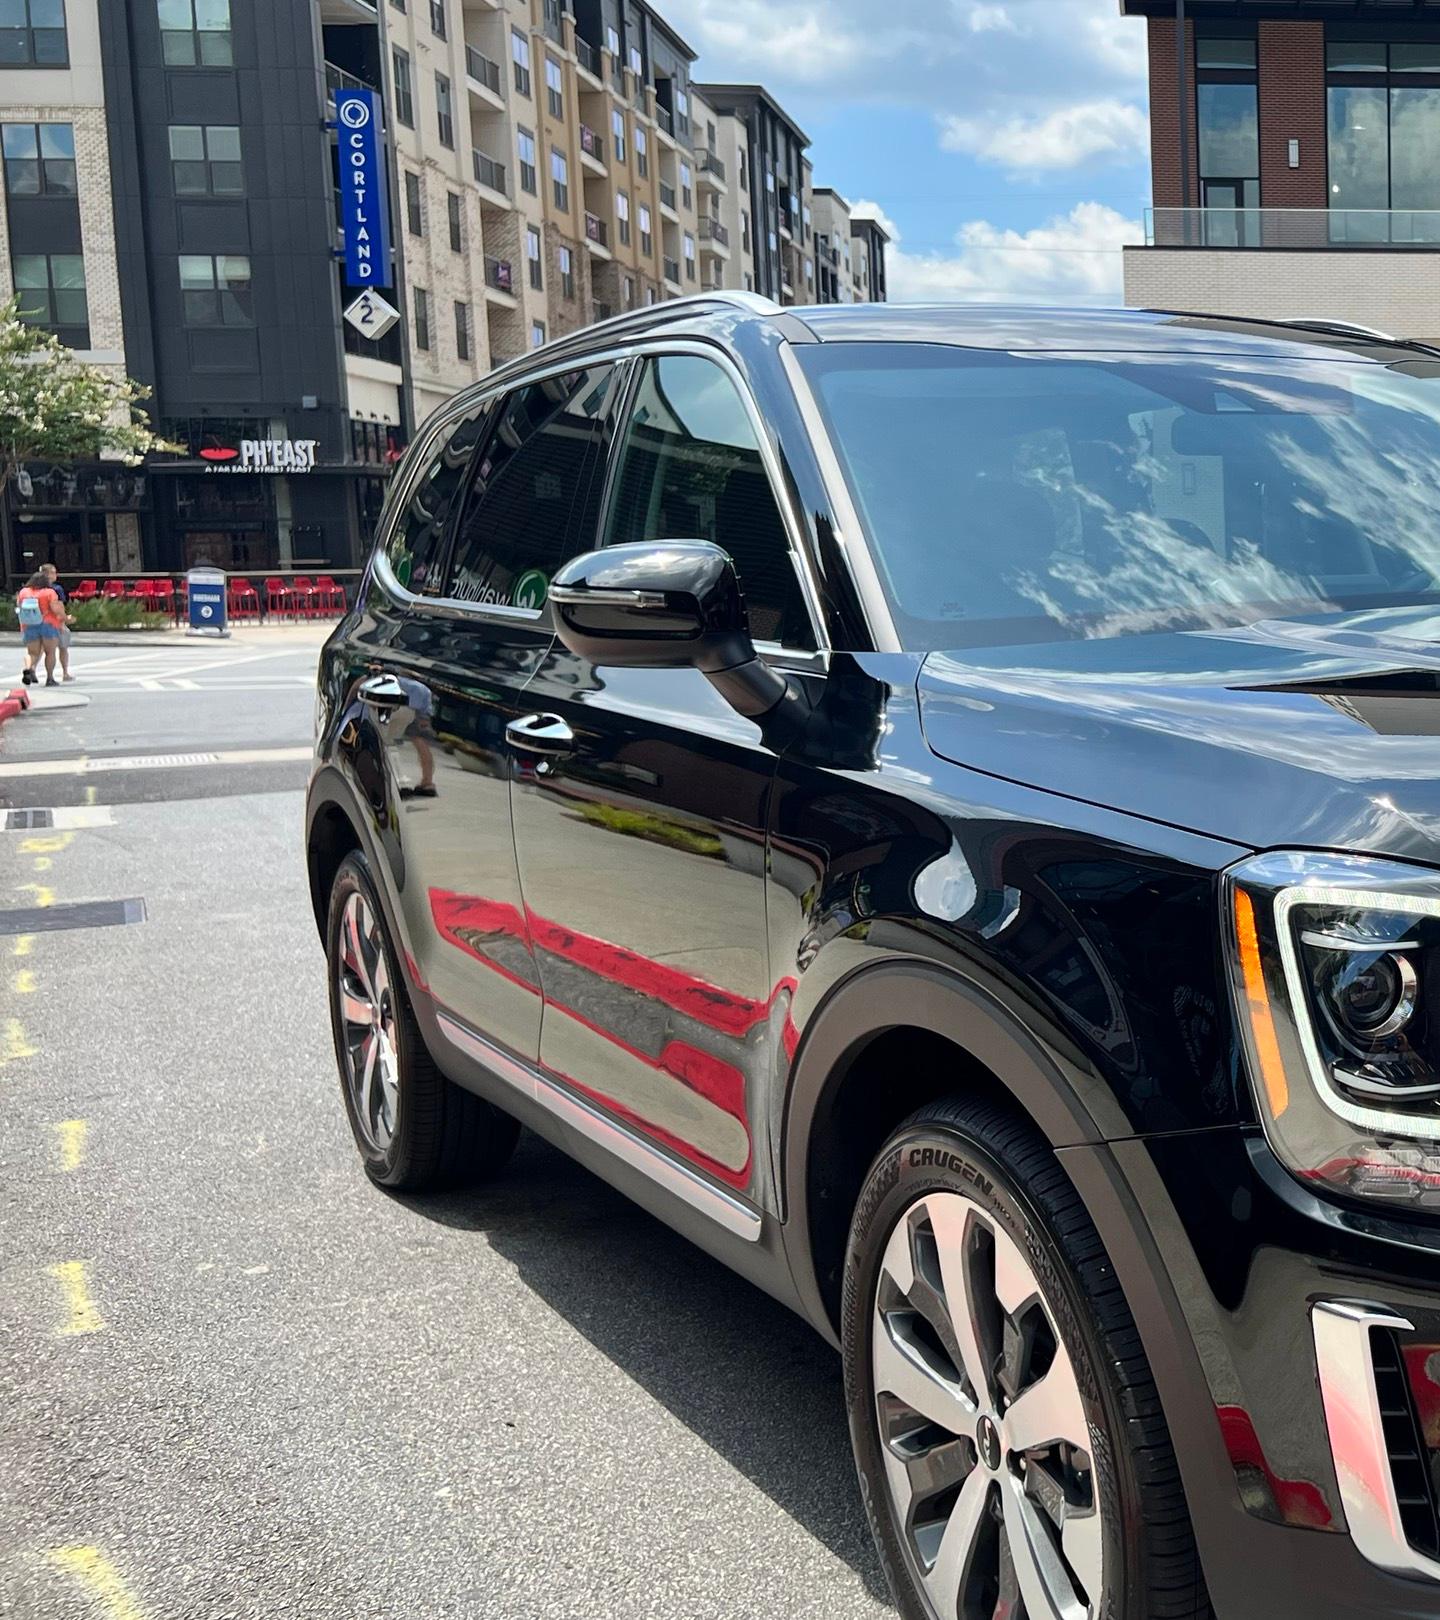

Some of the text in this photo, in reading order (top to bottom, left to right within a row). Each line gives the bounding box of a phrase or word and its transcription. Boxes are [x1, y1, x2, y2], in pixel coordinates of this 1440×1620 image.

[350, 133, 373, 279] CORTLAND
[360, 304, 374, 324] 2
[909, 1148, 994, 1197] CRUGEN
